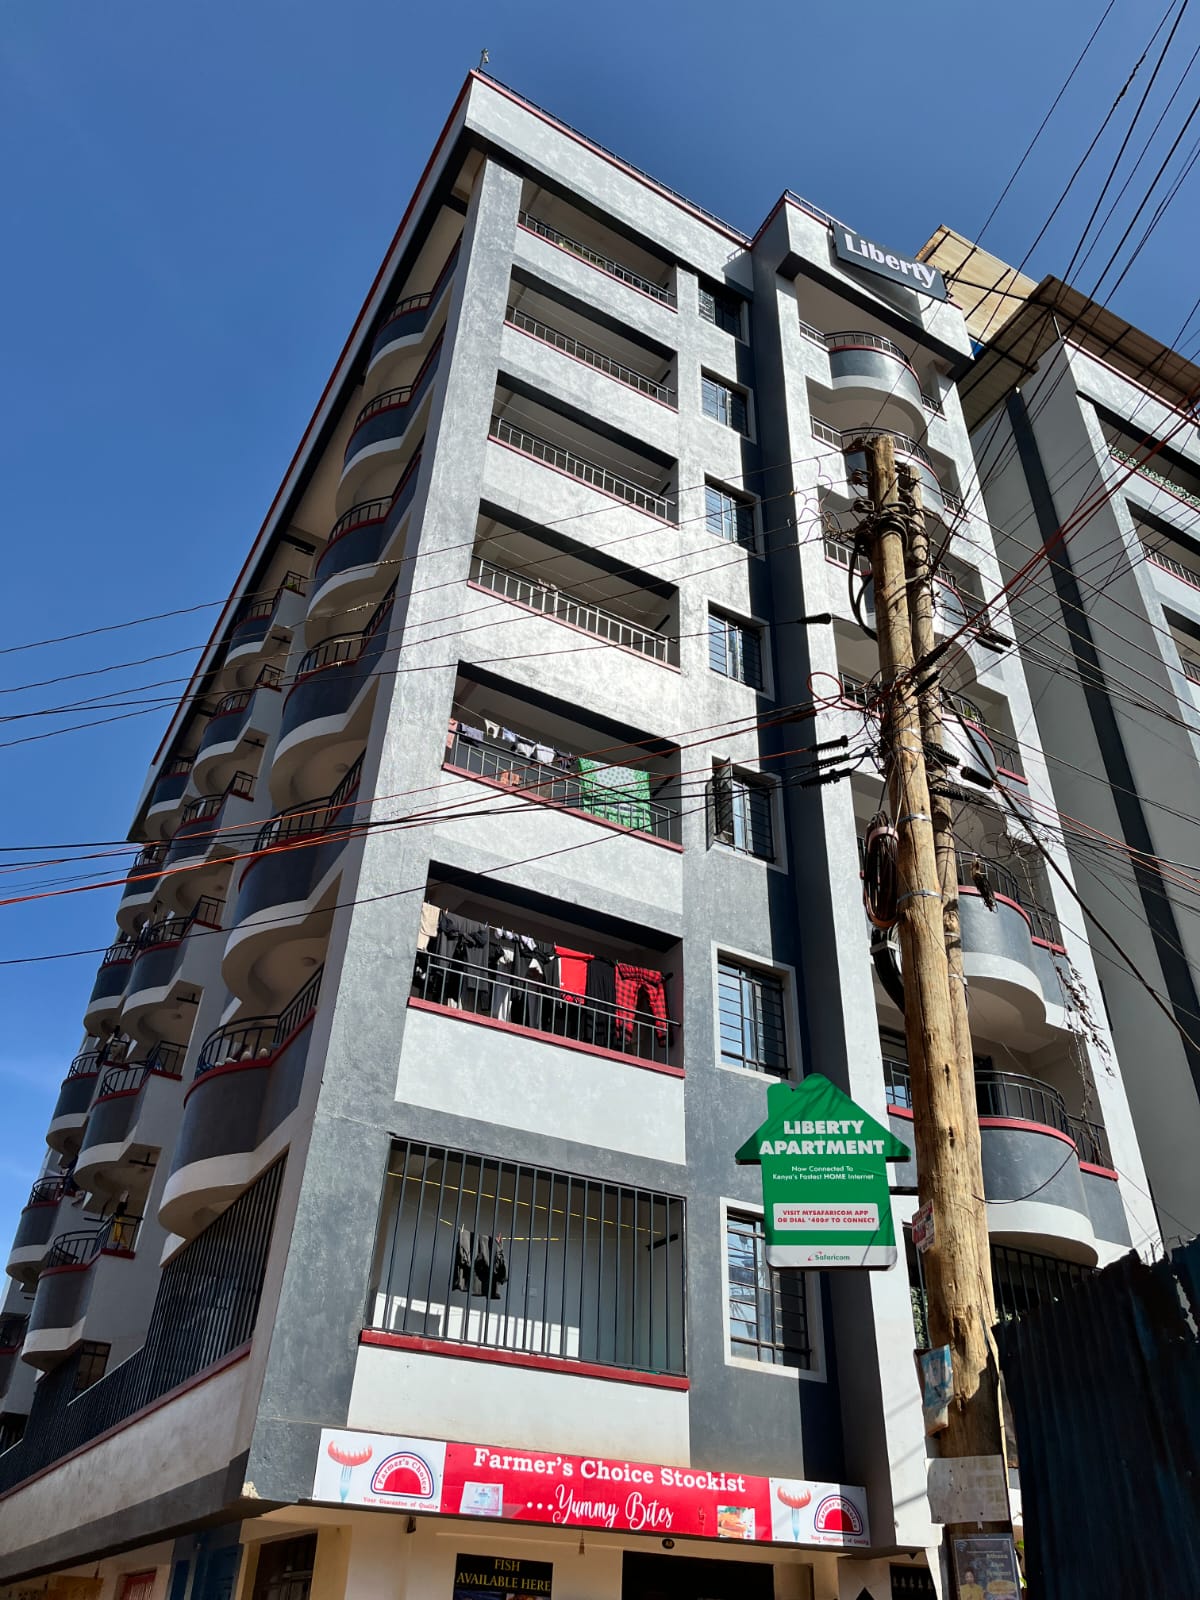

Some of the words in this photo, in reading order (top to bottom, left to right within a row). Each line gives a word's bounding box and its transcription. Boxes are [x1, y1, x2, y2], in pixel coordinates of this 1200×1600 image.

[844, 233, 936, 288] Liberty
[783, 1120, 865, 1135] LIBERTY
[759, 1140, 885, 1155] APARTMENT
[772, 1173, 798, 1181] Kenya's
[815, 1253, 850, 1261] Safaricom
[377, 1459, 410, 1485] Farmer's
[411, 1462, 427, 1491] Choice
[473, 1447, 573, 1477] Farmer's
[581, 1460, 654, 1483] Choice
[661, 1467, 746, 1493] Stockist
[625, 1491, 674, 1531] Bites
[494, 1559, 521, 1572] FISH
[456, 1572, 518, 1589] AVAILABLE
[521, 1578, 552, 1592] HERE
